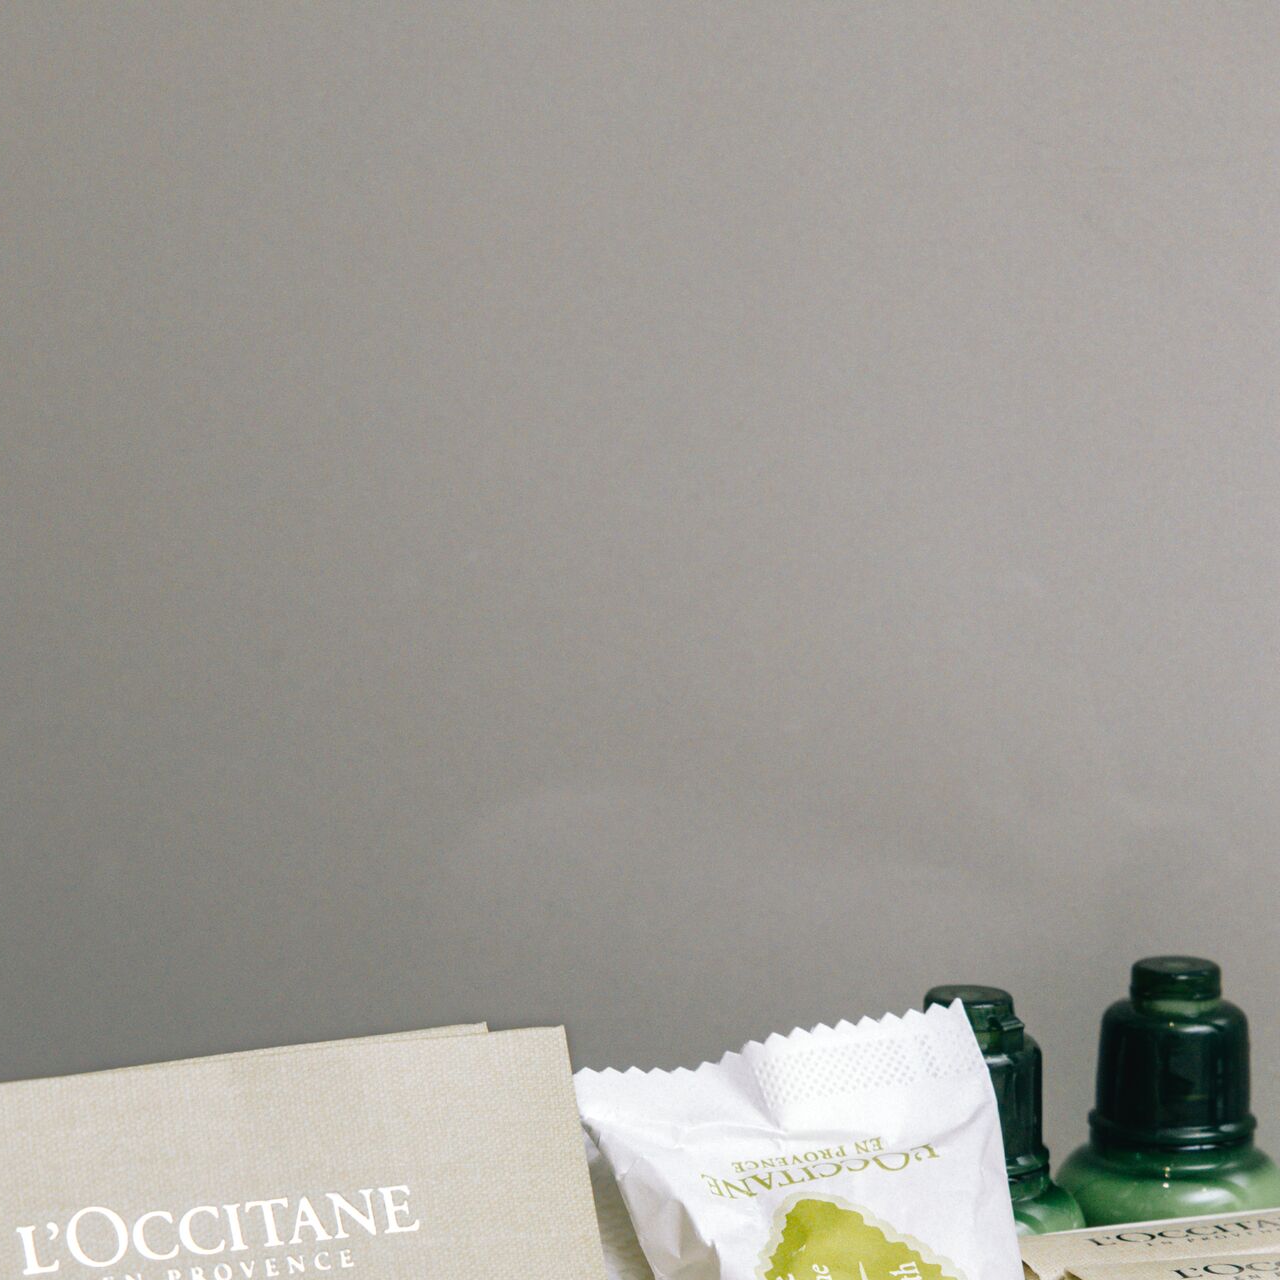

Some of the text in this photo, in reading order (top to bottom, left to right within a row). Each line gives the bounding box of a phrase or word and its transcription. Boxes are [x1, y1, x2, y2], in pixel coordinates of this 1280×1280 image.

[701, 1142, 941, 1199] L'OCCITANE
[731, 1136, 885, 1173] EN PROVENCE
[16, 1185, 420, 1275] L'OCCITANE
